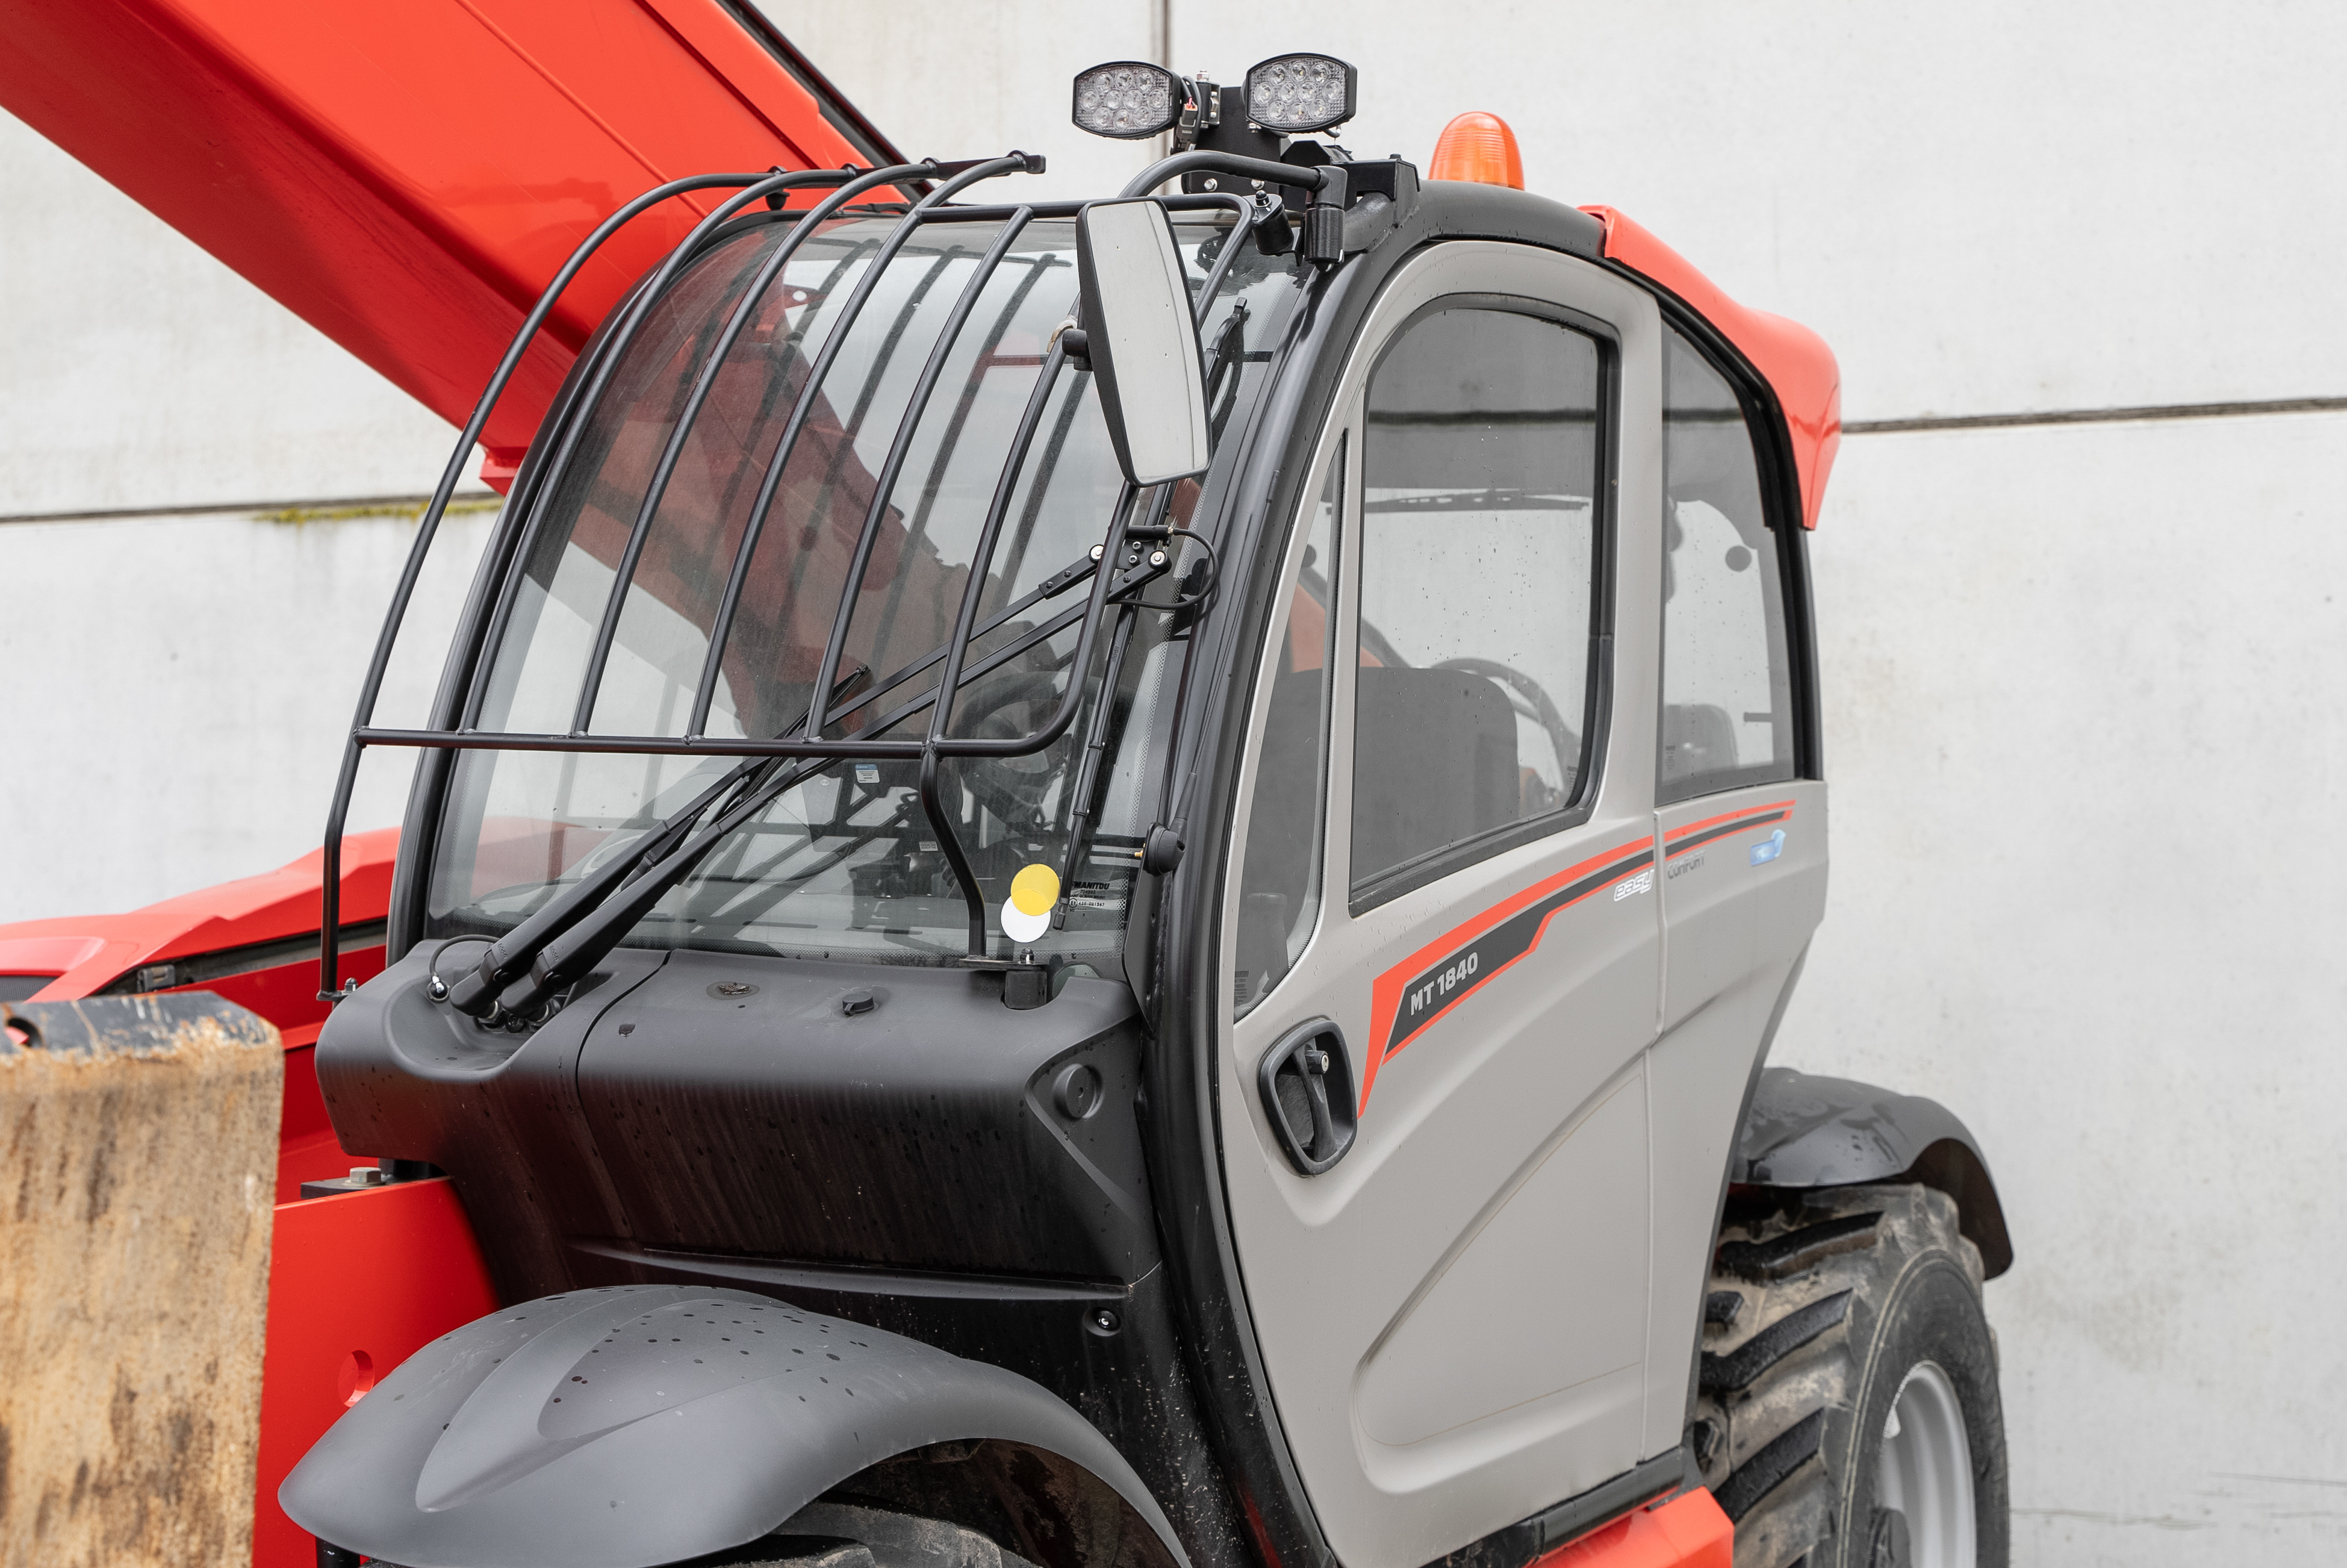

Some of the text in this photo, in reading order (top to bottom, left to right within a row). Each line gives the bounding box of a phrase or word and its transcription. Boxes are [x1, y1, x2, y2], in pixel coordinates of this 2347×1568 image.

[1073, 881, 1110, 890] MANITOU
[1614, 868, 1655, 902] easy
[1411, 951, 1479, 1016] MT 1840
